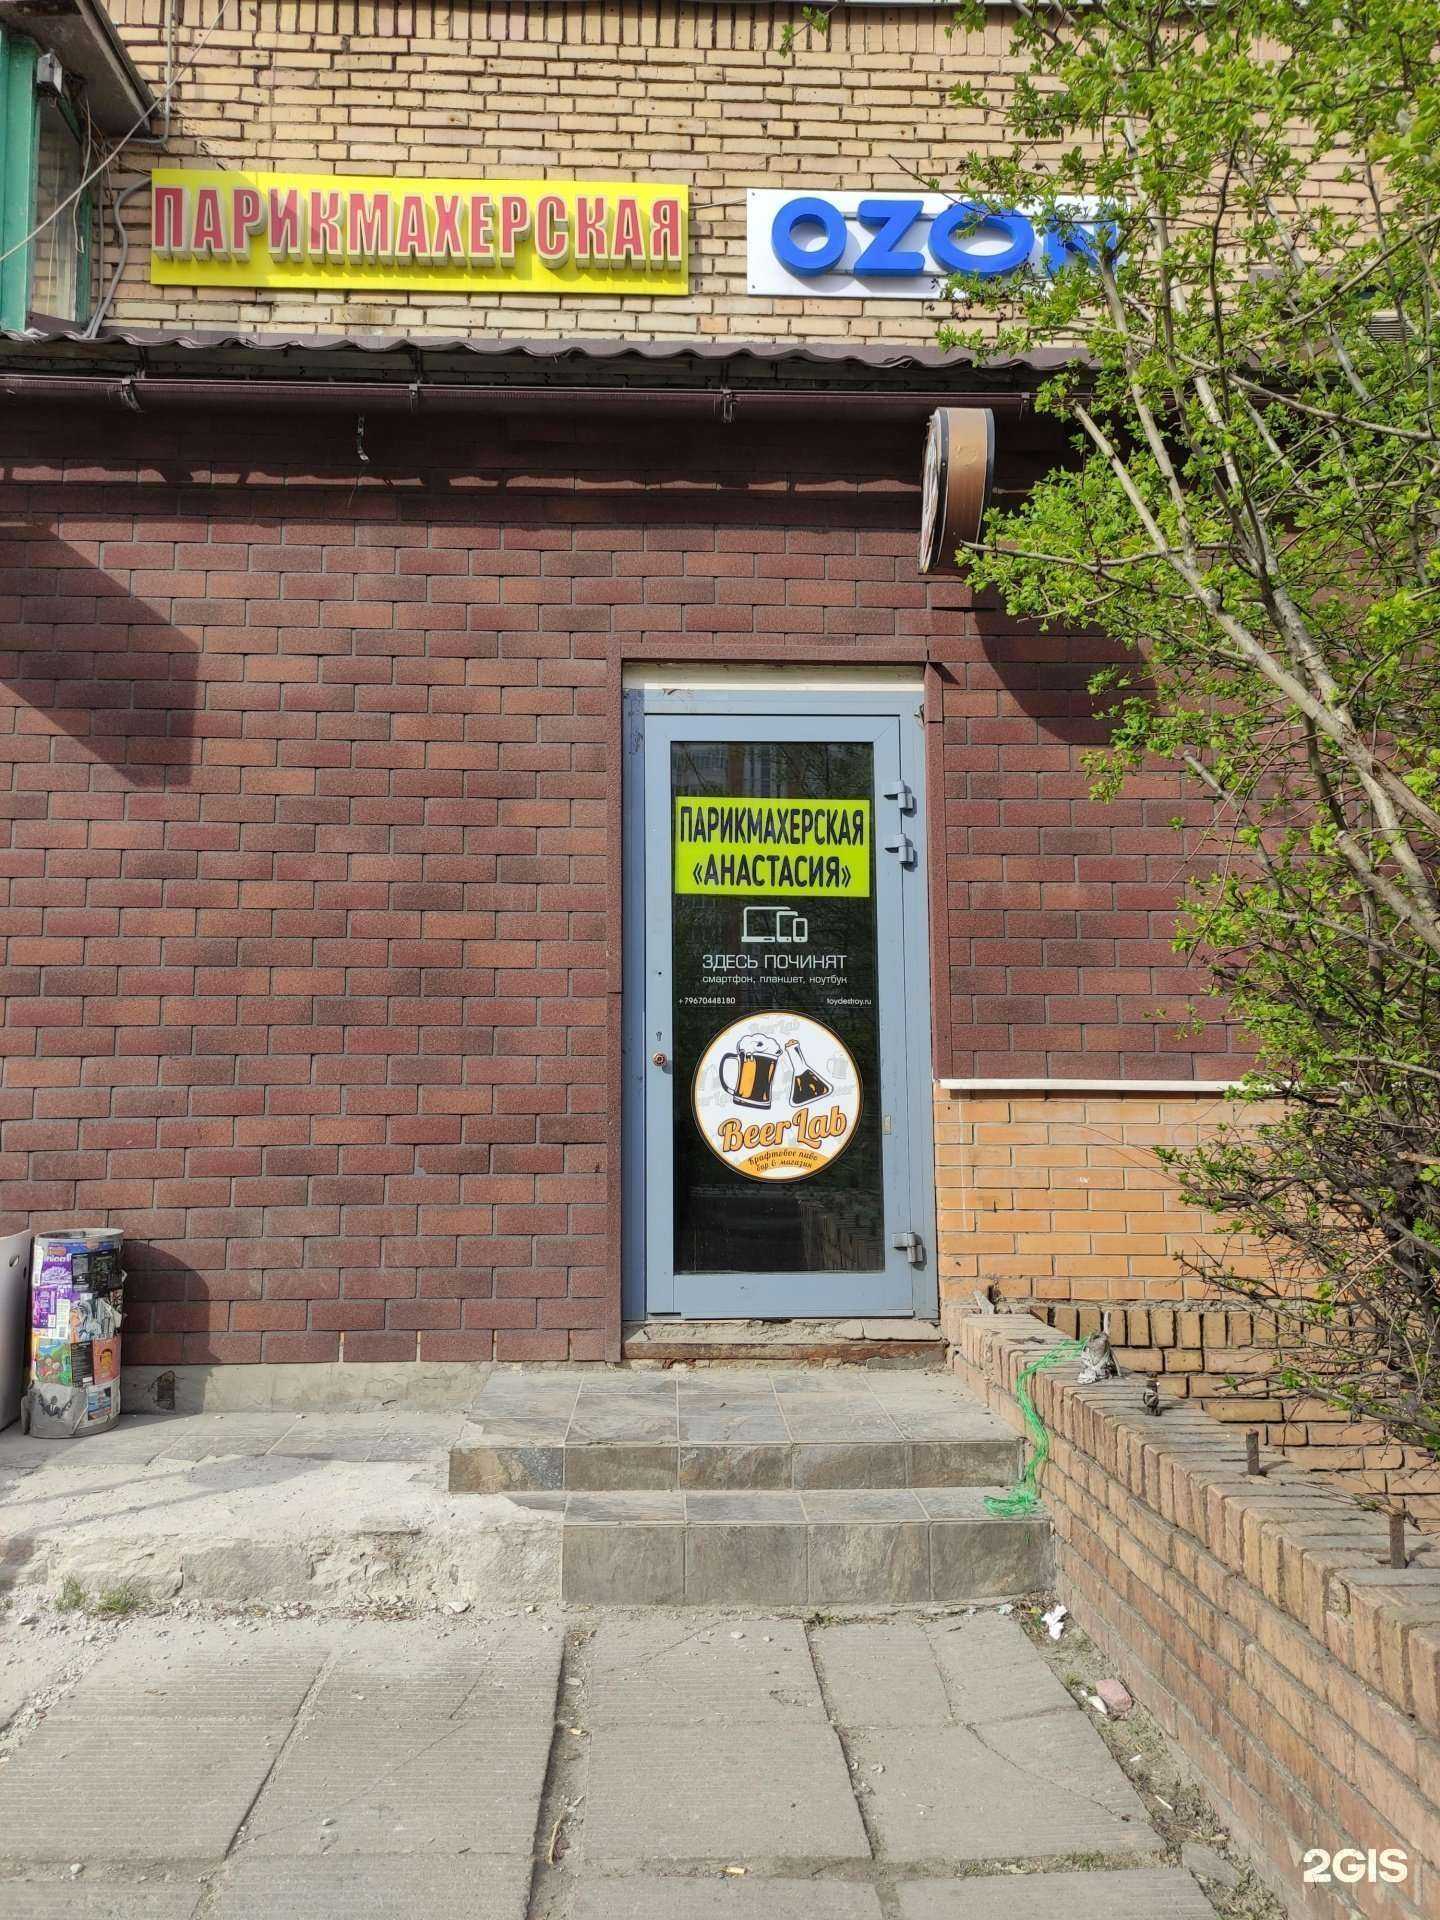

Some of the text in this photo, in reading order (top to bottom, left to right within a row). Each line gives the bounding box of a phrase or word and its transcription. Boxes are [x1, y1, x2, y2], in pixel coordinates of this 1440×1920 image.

[153, 185, 682, 269] ПАРИКМАХЕРСКАЯ
[680, 806, 864, 846] ПАРИКМАХЕРСКАЯ
[692, 854, 852, 888] «АНАСТАСИЯ»
[702, 954, 848, 971] ЗДЕСЬ ПОЧИНЯТ
[702, 974, 848, 985] смартфон, планшет, ноутбук
[718, 1105, 847, 1152] Beer Lab
